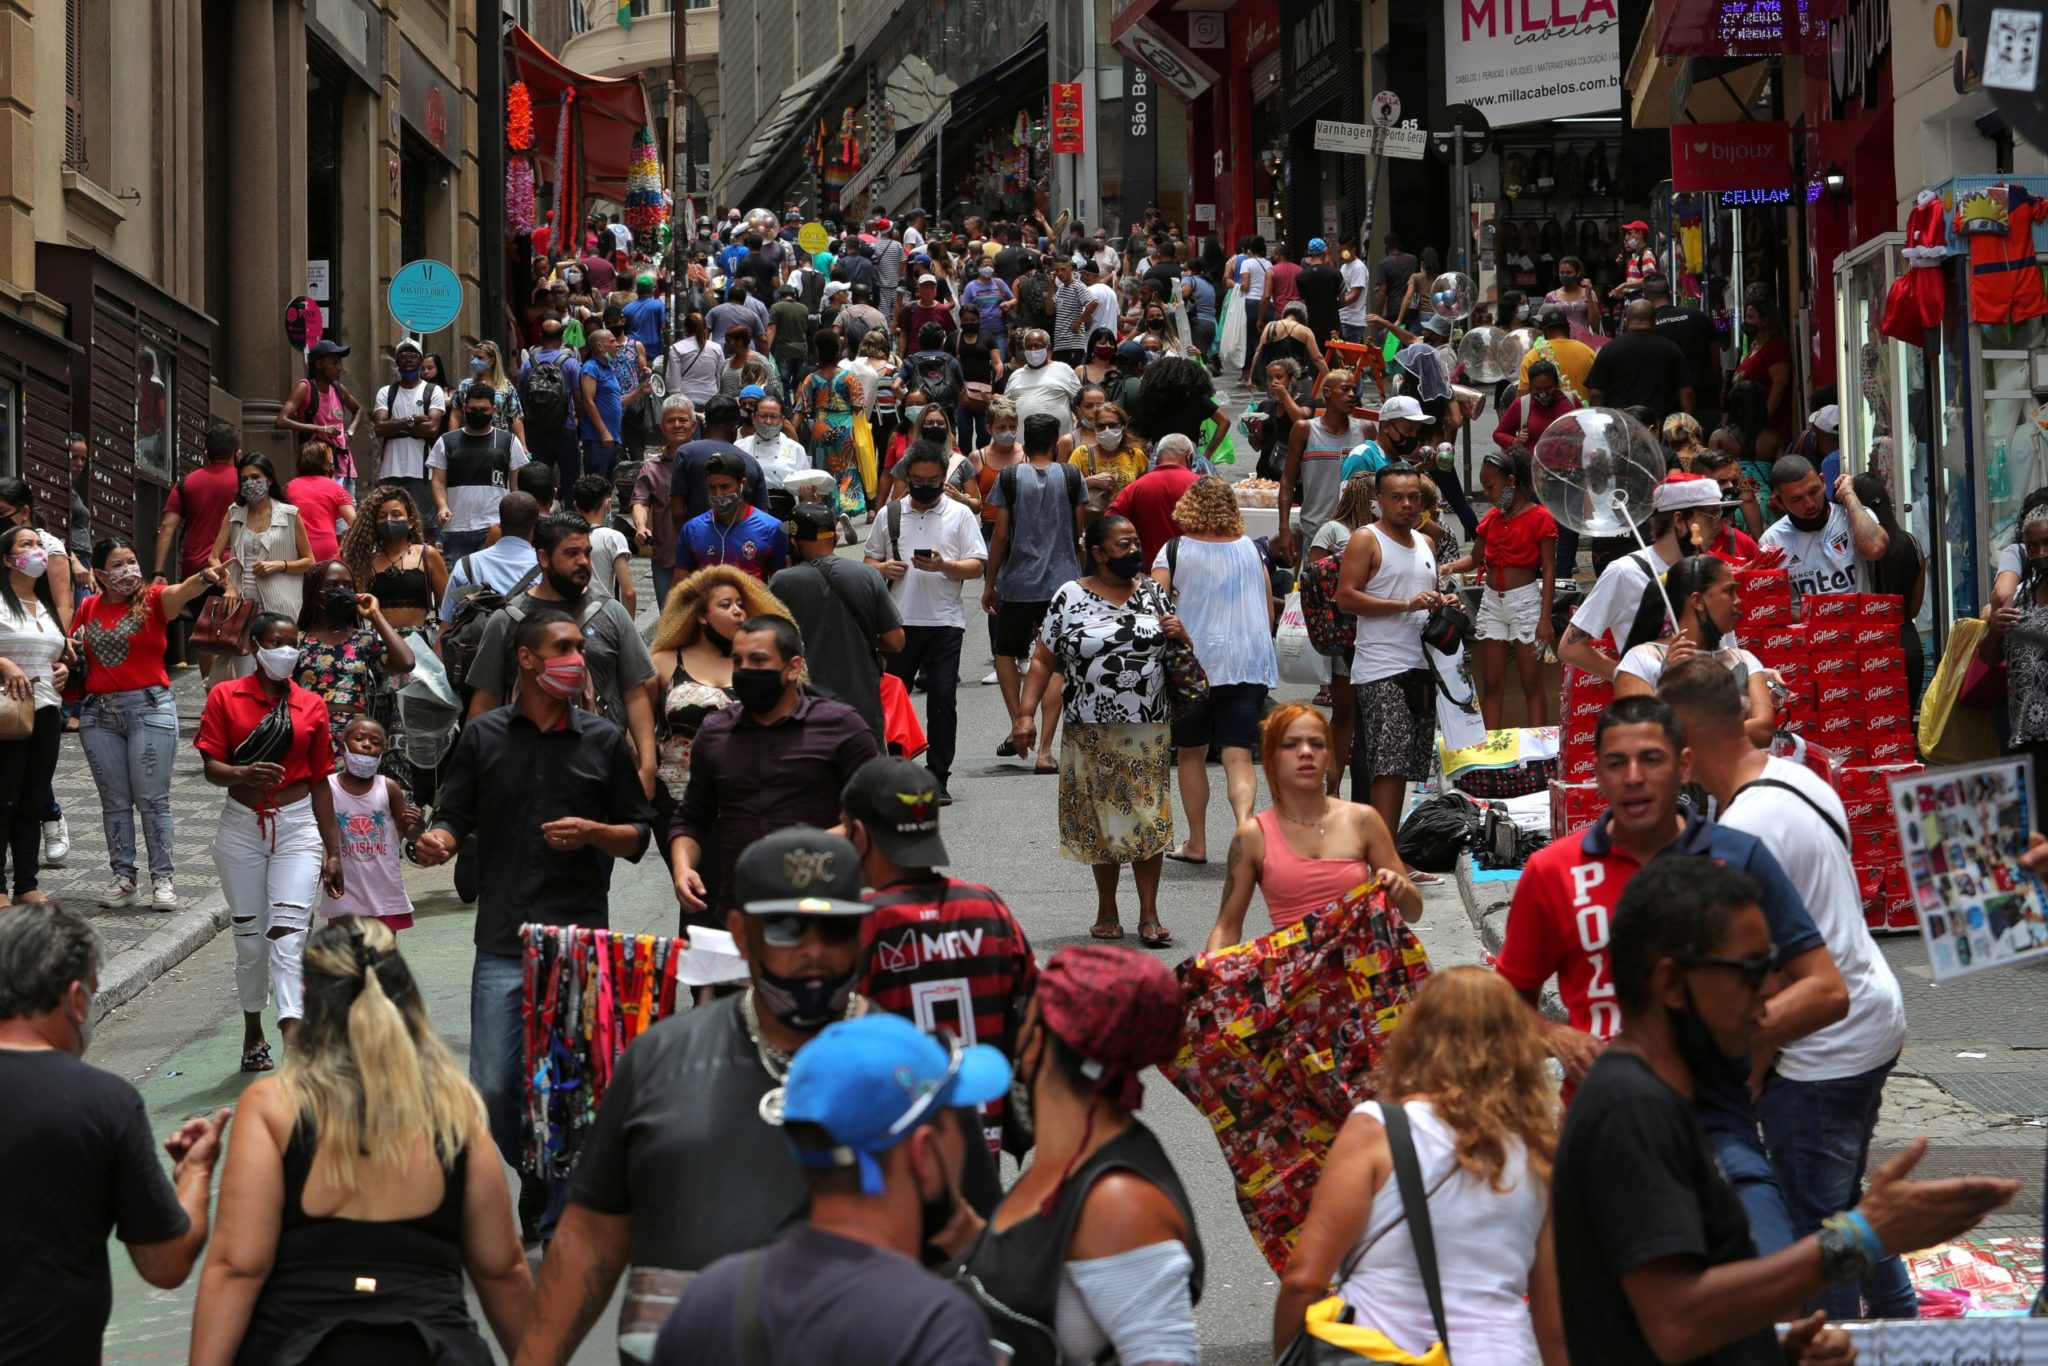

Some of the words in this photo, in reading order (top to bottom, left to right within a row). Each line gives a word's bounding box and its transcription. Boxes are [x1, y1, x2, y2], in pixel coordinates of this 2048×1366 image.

[1513, 11, 1620, 46] cabelos
[1455, 73, 1478, 84] CABELOS
[1481, 69, 1505, 80] PERUCAS
[1510, 65, 1534, 76] APLIQUES
[1538, 59, 1564, 72] MATERIAIS
[1564, 57, 1577, 69] PARA
[1131, 67, 1147, 96] Be
[1377, 95, 1399, 107] MILLA
[1131, 102, 1147, 136] São
[1401, 118, 1418, 131] 85
[1317, 121, 1372, 140] Varnhagen
[1385, 128, 1405, 142] Porto
[1407, 130, 1426, 144] Geral
[1711, 141, 1775, 164] bijoux
[1722, 188, 1789, 204] CELULAR
[1747, 575, 1775, 592] Suflair
[1748, 604, 1777, 621] Suflair
[1815, 600, 1845, 617] Suflair
[1861, 600, 1891, 616] Suflair
[1765, 633, 1793, 650] Suflair
[1810, 628, 1840, 645] Suflair
[1855, 629, 1885, 644] Suflair
[1814, 658, 1843, 675] Suflair
[1861, 656, 1890, 673] Suflair
[1820, 685, 1850, 703] Suflair
[1865, 685, 1895, 702] Suflair
[1573, 702, 1603, 717] Suflair
[1822, 716, 1850, 734] Suflair
[1867, 714, 1896, 731] Suflair
[1872, 742, 1900, 759] Suflair
[341, 842, 388, 858] SUNSHINE
[921, 927, 984, 962] MRV
